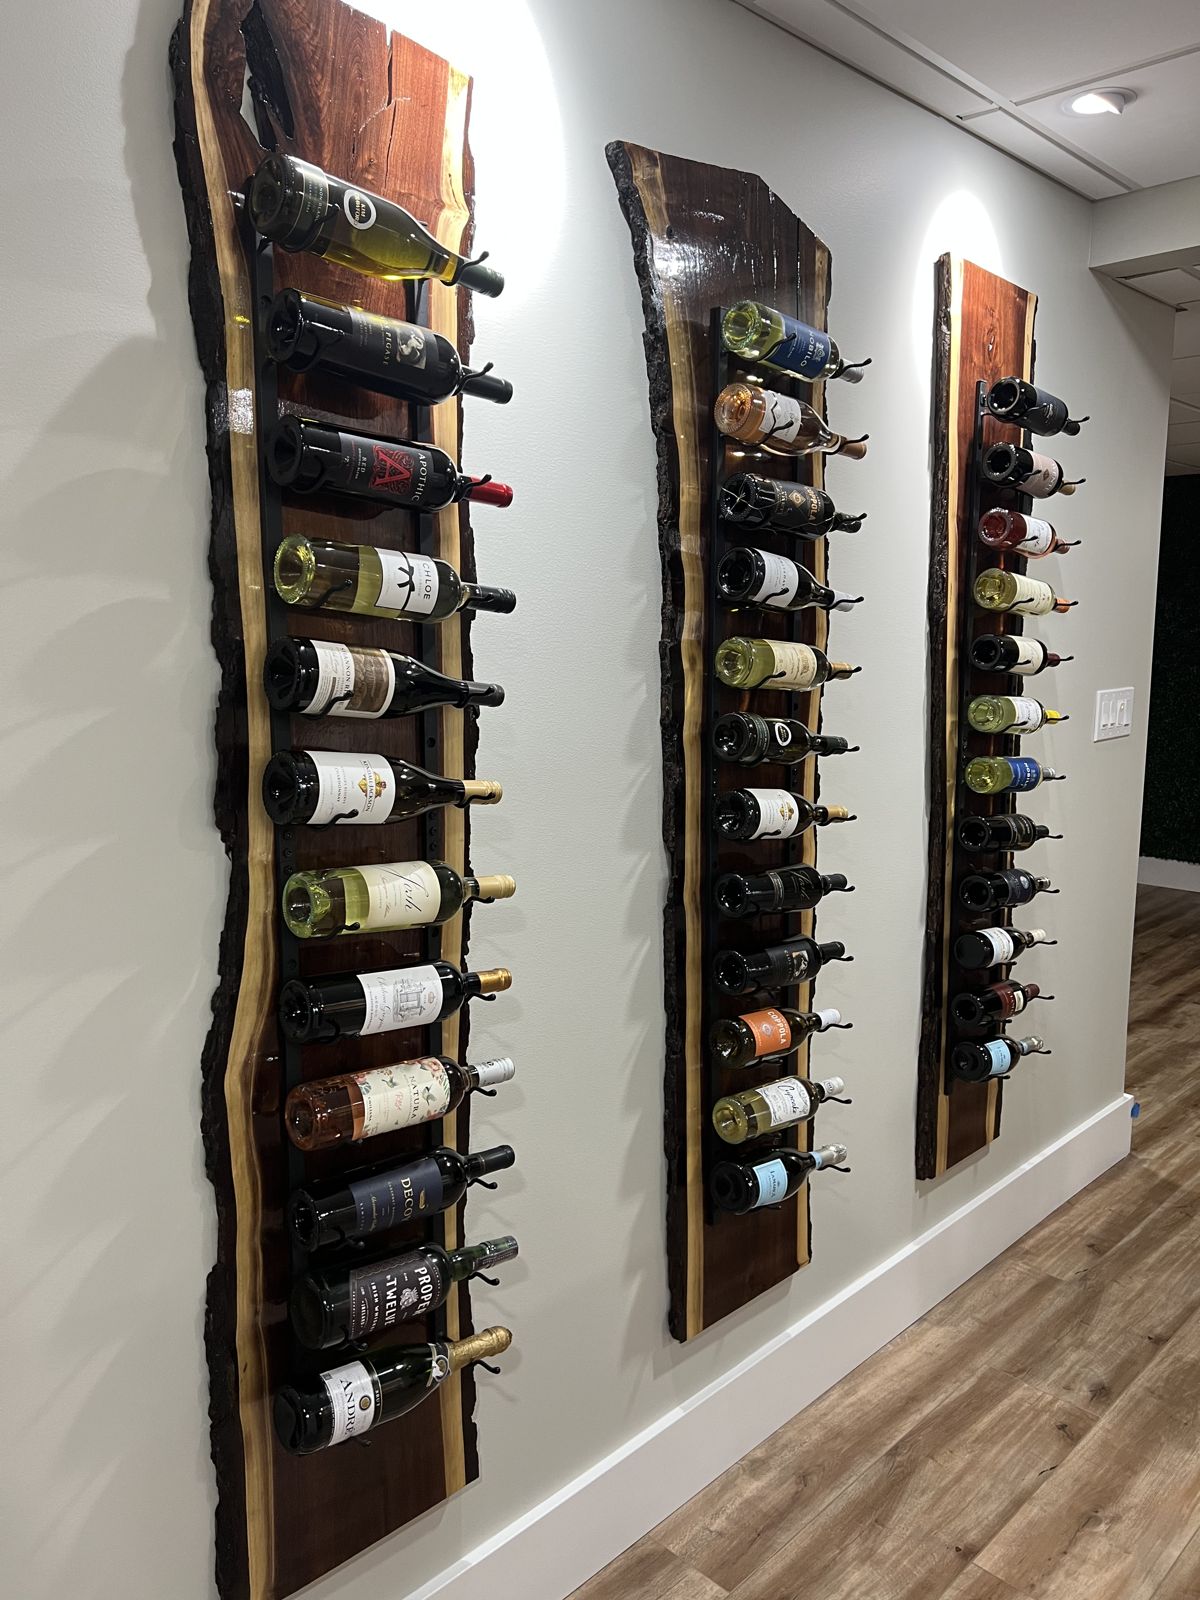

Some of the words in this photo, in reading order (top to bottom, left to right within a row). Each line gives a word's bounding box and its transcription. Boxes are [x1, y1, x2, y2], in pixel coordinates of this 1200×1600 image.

[382, 331, 392, 367] PEGASE
[800, 329, 816, 368] NOBILO
[411, 451, 428, 502] APOTHIC
[422, 562, 432, 600] CHLOE
[768, 1011, 787, 1044] COPPOLA
[409, 1075, 420, 1119] NATURA
[777, 1085, 799, 1114] Cupcake
[400, 1177, 414, 1222] DECOY
[370, 1282, 379, 1303] IRISH
[384, 1277, 398, 1326] TWELVE
[411, 1266, 434, 1317] PROPER
